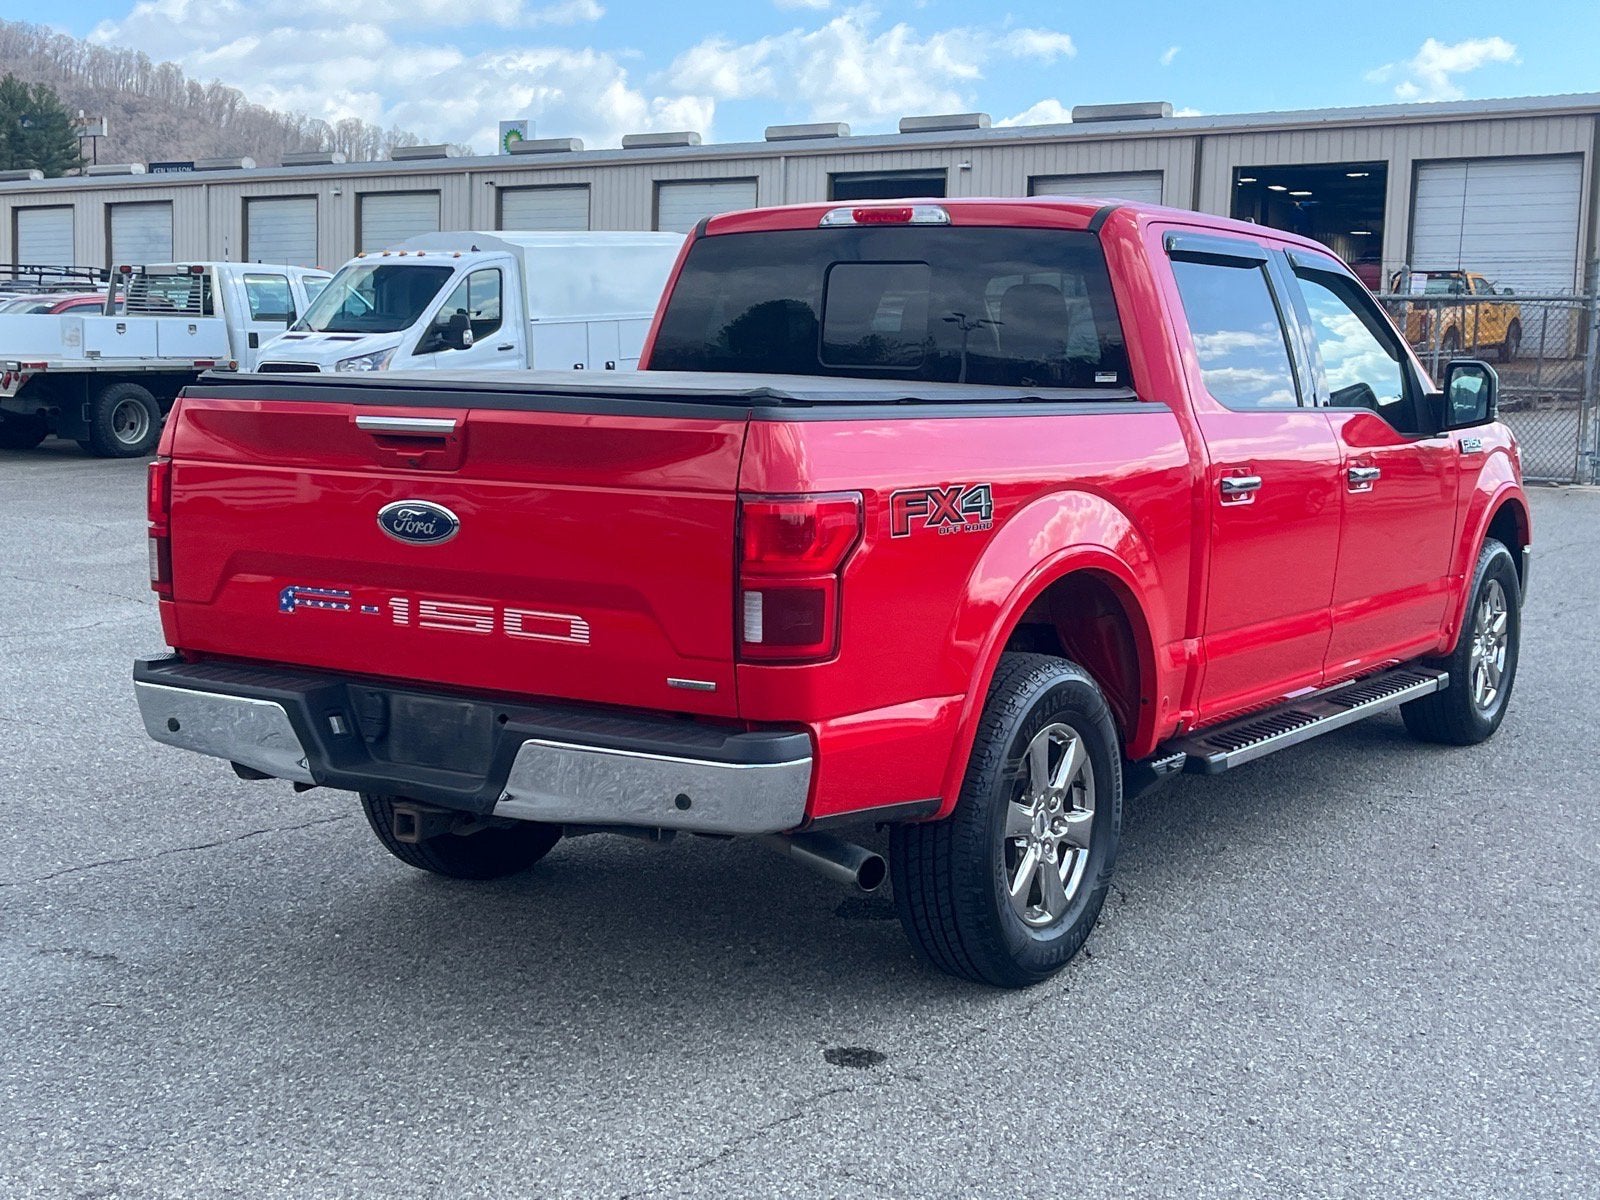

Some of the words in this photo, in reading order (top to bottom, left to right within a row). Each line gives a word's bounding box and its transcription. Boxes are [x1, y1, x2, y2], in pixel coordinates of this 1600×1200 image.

[393, 508, 437, 535] Ford
[889, 483, 994, 539] FX4
[938, 525, 960, 535] OFF
[964, 521, 993, 532] ROAD
[278, 585, 591, 645] F-150
